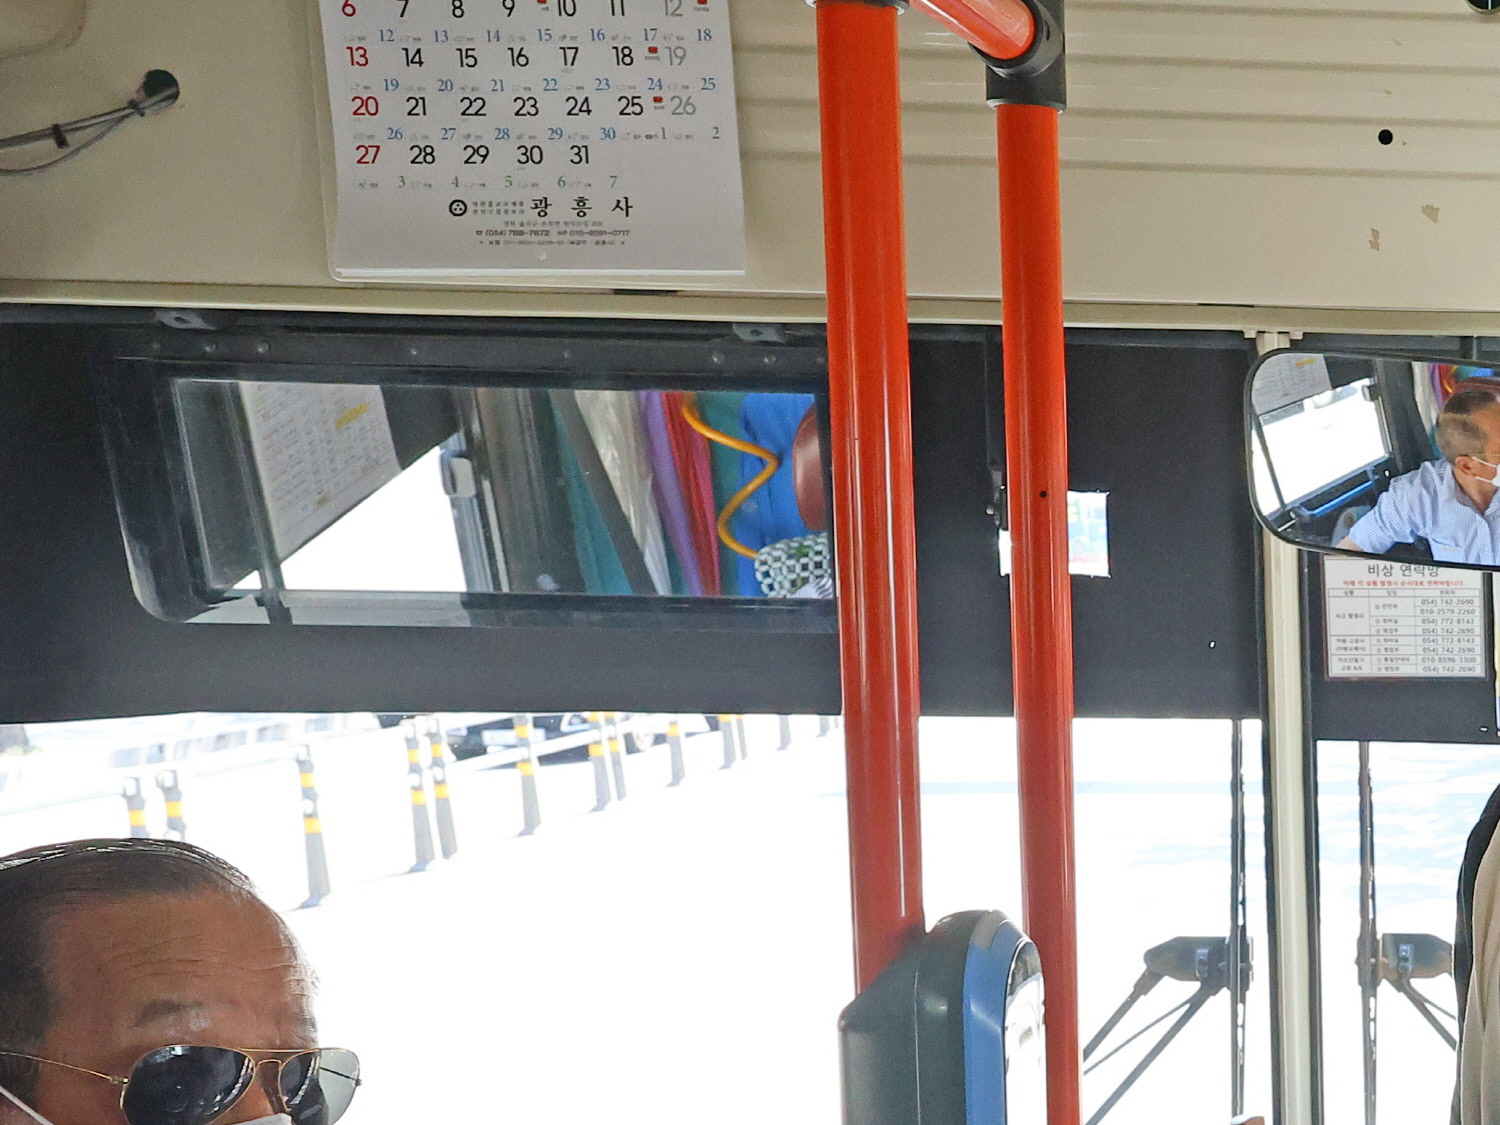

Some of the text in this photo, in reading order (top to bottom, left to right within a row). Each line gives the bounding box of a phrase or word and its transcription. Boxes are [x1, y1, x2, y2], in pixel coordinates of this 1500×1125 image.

[342, 0, 356, 17] 6
[397, 0, 409, 17] 7
[452, 0, 464, 18] 8
[502, 0, 515, 17] 9
[558, 0, 576, 16] 10
[611, 0, 625, 16] 11
[664, 0, 683, 17] 12
[380, 28, 712, 42] 12 13 14 15 16 17 18
[346, 46, 686, 67] 13 14 15 16 17 18 19
[384, 78, 715, 91] 19 20 21 22 23 24 25
[352, 96, 696, 116] 20 21 22 23 24 25 26
[388, 127, 719, 140] 26 27 28 29 30 1 2
[356, 145, 589, 164] 27 28 29 30 31
[530, 197, 634, 217] 광 흥 사
[1367, 564, 1394, 577] 비상
